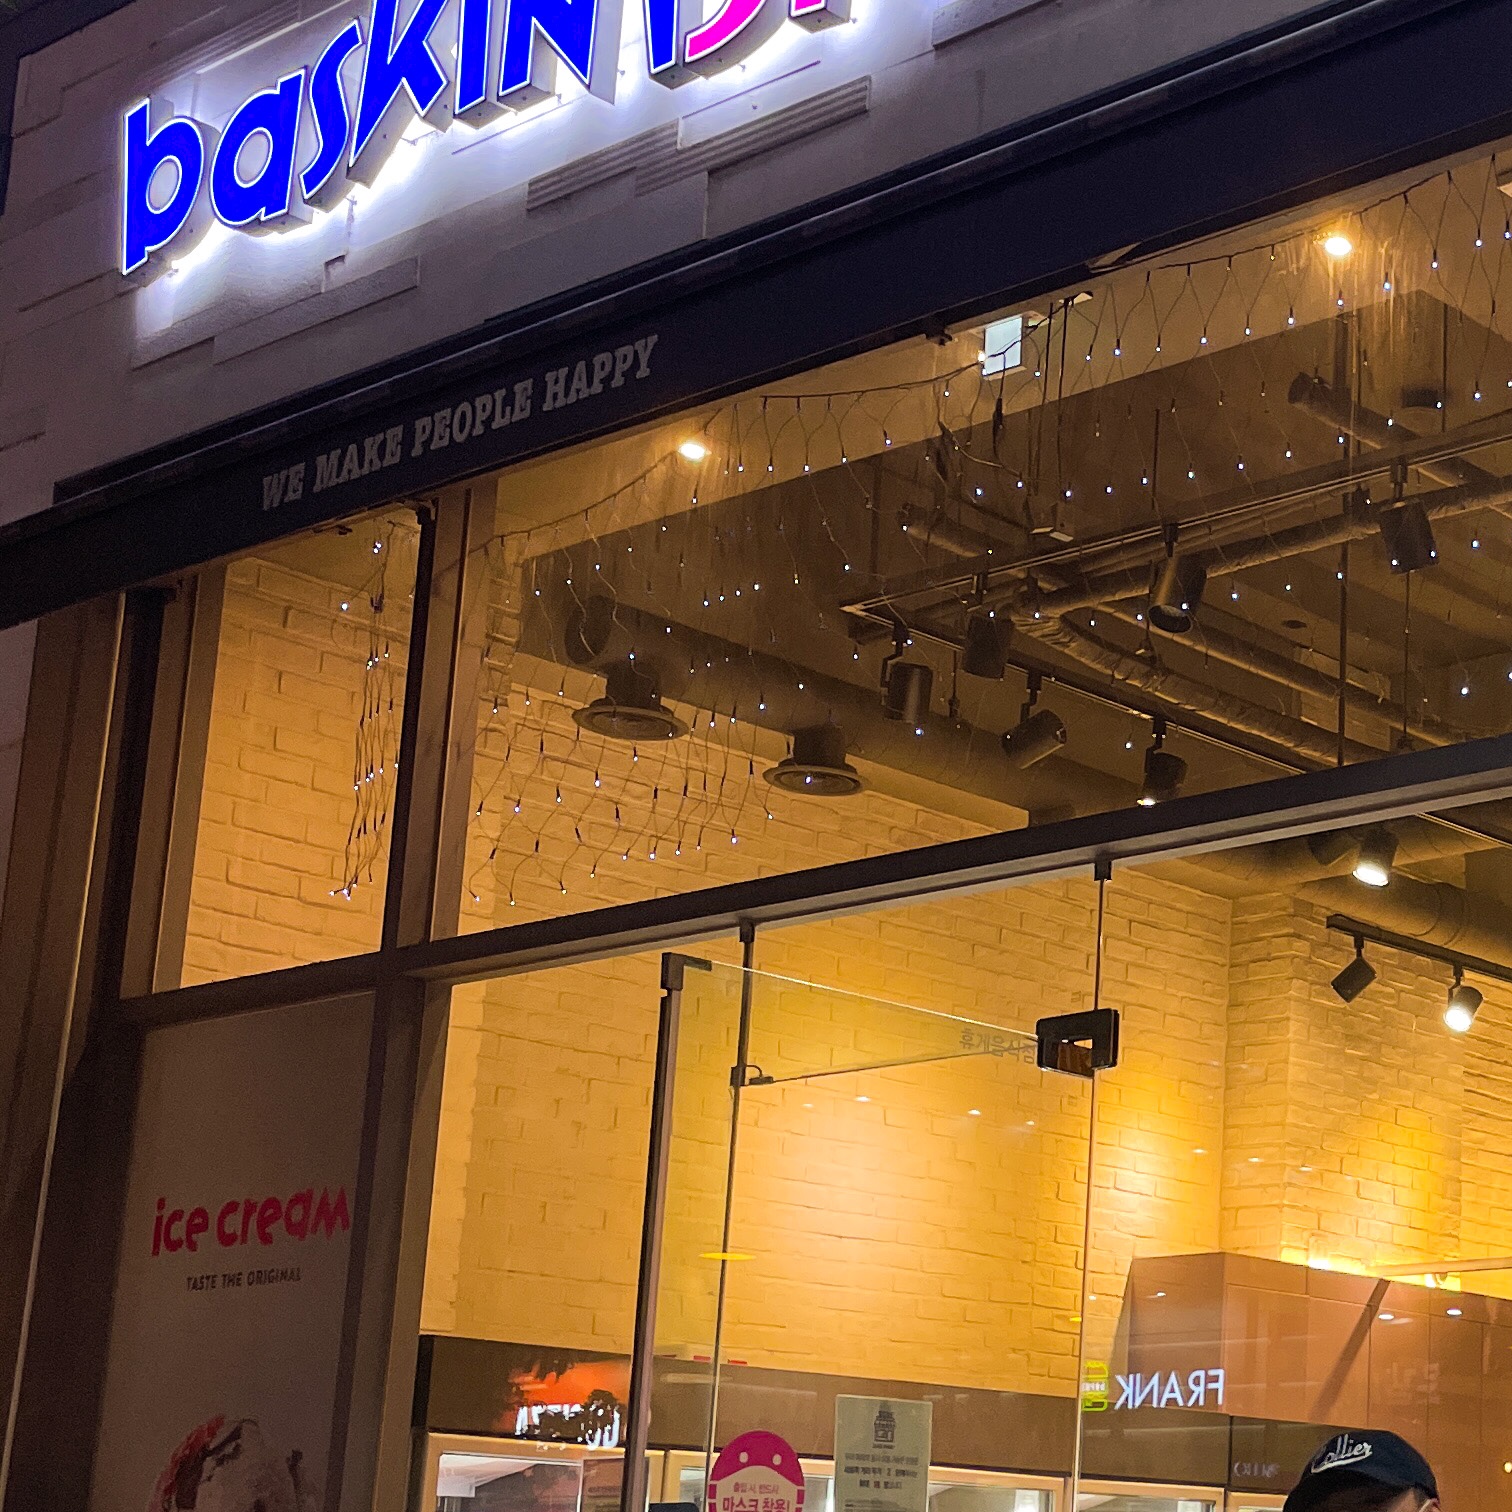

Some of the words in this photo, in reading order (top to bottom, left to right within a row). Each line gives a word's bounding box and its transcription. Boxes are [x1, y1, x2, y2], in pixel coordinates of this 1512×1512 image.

[260, 468, 305, 513] WE
[313, 434, 402, 501] MAKE
[411, 378, 534, 460] PEOPLE
[542, 335, 662, 412] HAPPY
[151, 1197, 210, 1257] ice
[215, 1186, 351, 1248] cream
[186, 1273, 217, 1292] TASTE
[221, 1271, 243, 1289] THE
[246, 1267, 301, 1287] ORIGINAL
